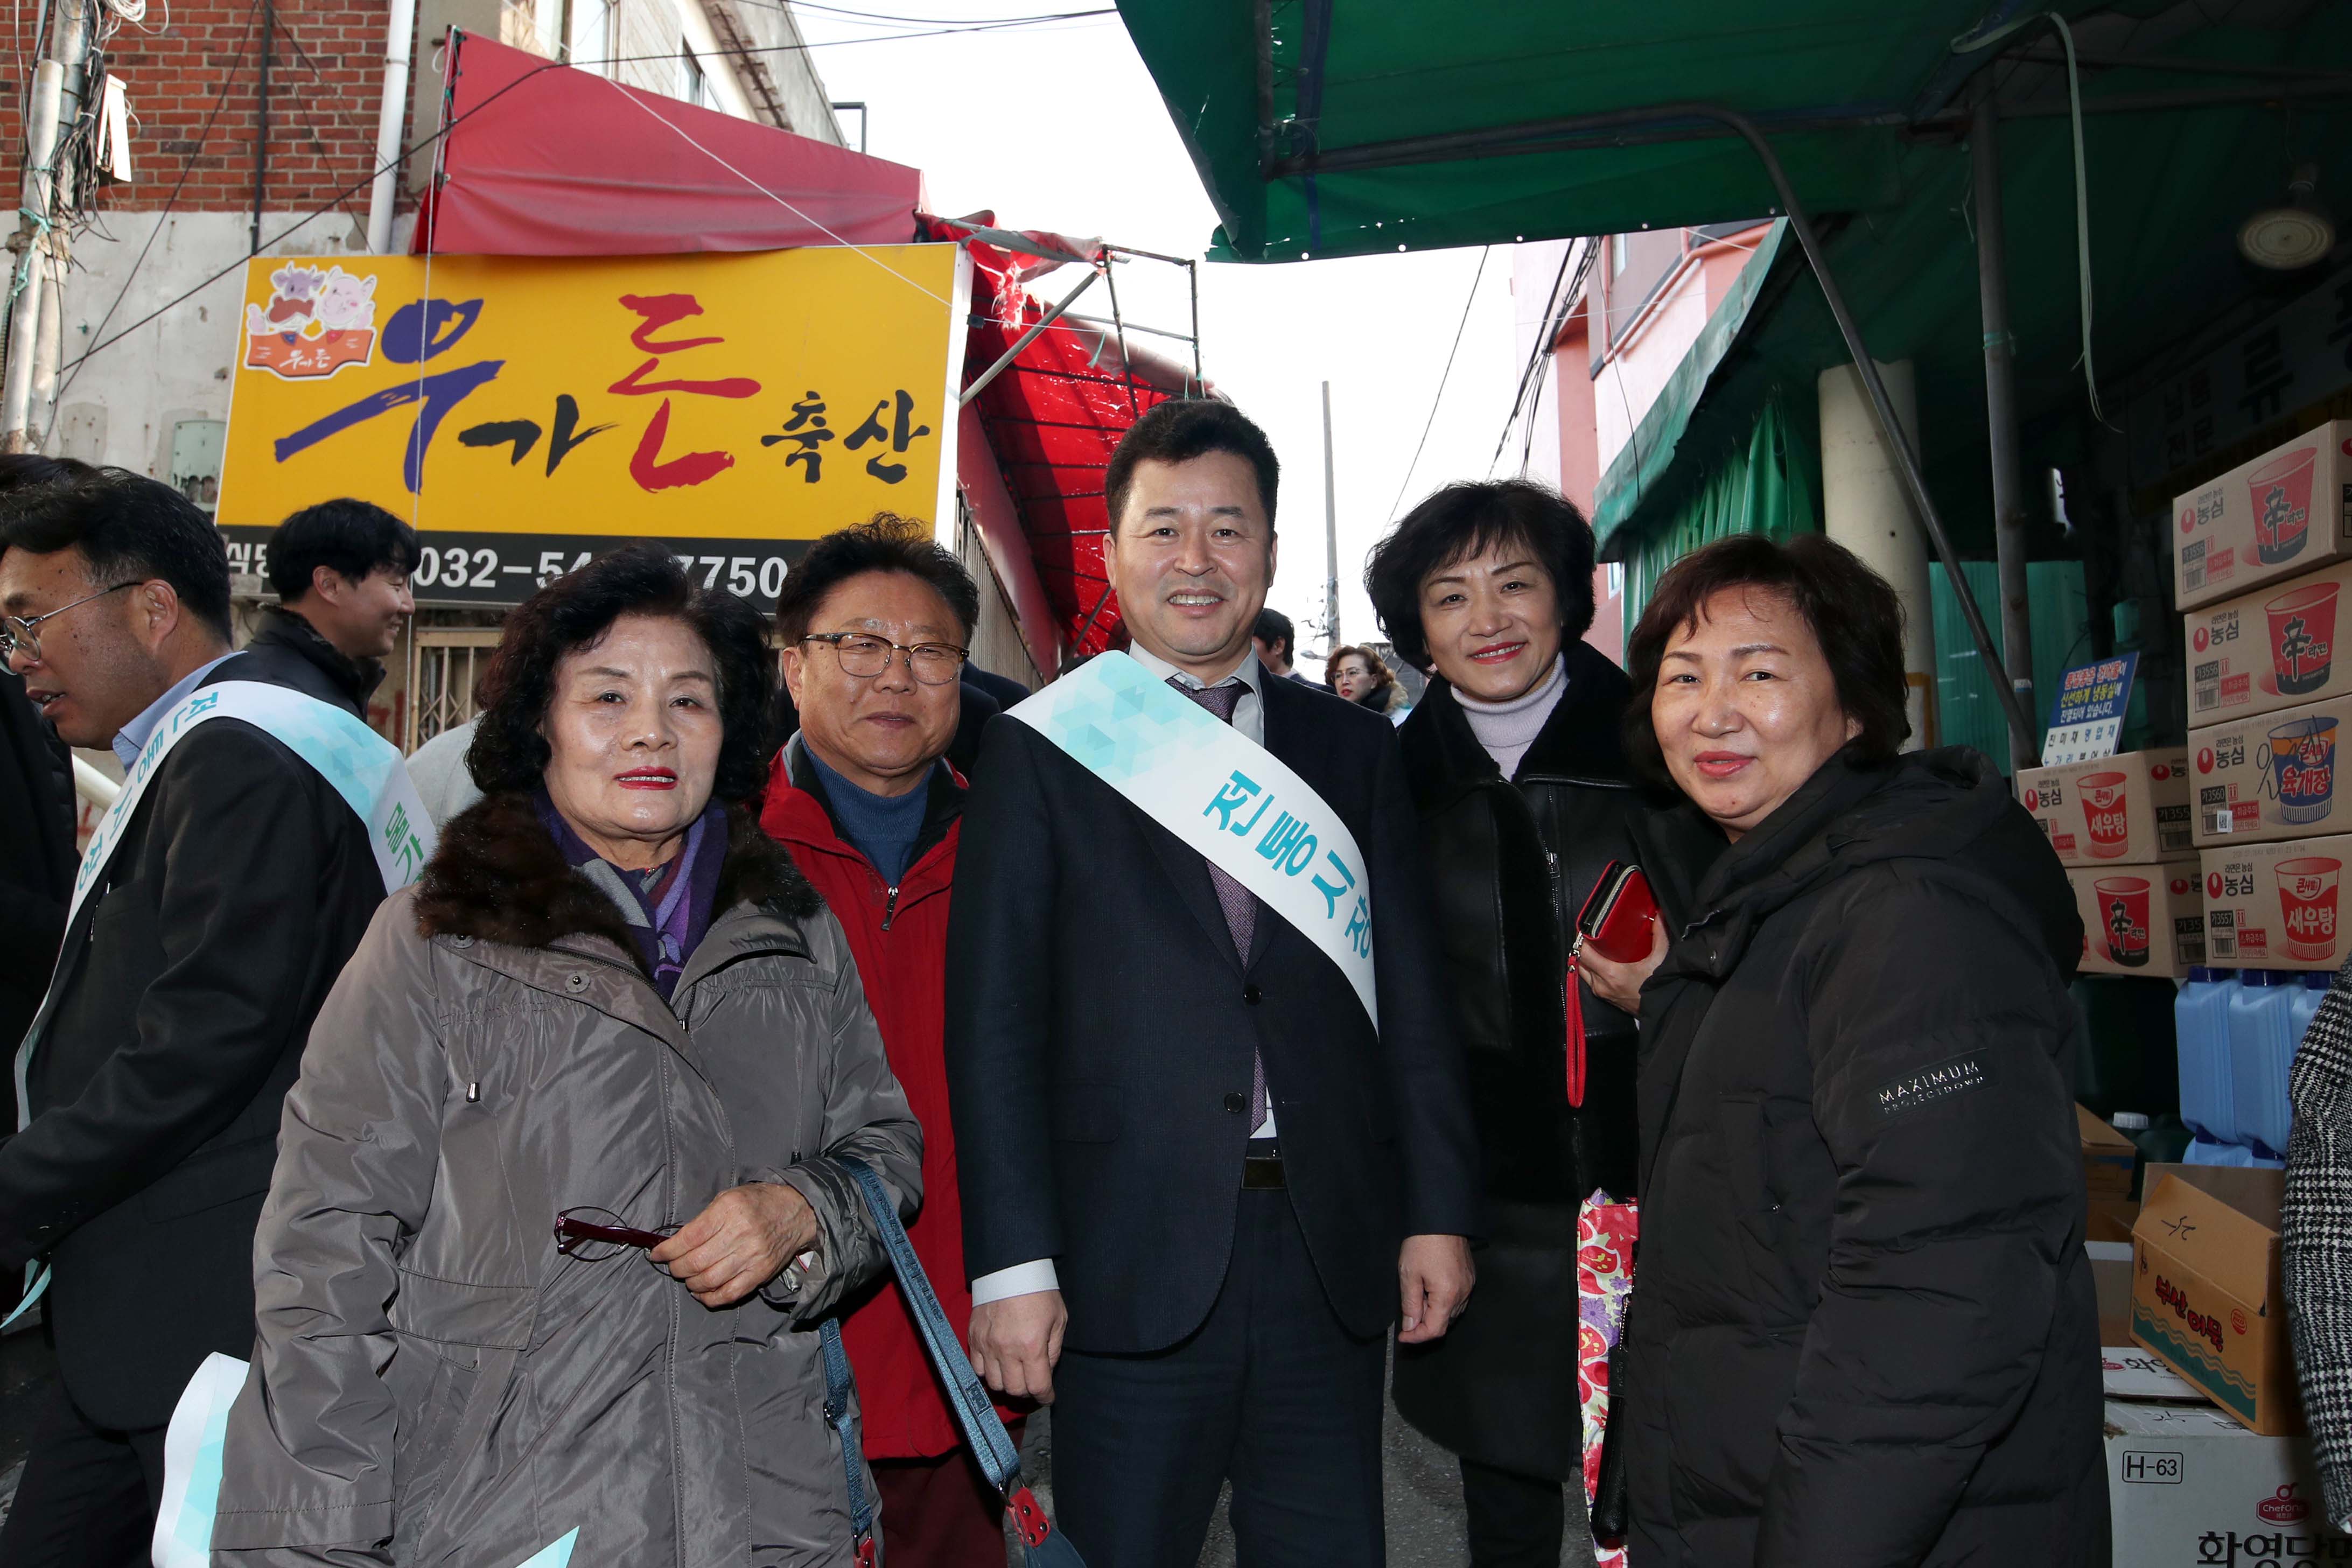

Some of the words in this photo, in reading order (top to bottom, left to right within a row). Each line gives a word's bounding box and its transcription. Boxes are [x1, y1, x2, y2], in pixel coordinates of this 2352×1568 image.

[760, 389, 930, 485] 축산
[2197, 497, 2224, 526] 농심
[2211, 620, 2239, 646] 농심
[2281, 615, 2312, 683] 辛
[2061, 687, 2092, 708] 신선하게
[2232, 735, 2244, 746] 농심
[2216, 746, 2244, 769] 농심
[79, 691, 219, 891] 전통시장
[2281, 766, 2331, 798] 육개장
[2039, 789, 2062, 808] 농심
[2202, 788, 2225, 804] 가3560
[2091, 812, 2126, 836] 새우탕
[1202, 769, 1371, 959] 전통시장
[2225, 864, 2241, 873] 라면은
[2242, 862, 2253, 873] 농심
[2225, 874, 2254, 897] 농심
[2211, 913, 2232, 926] 가3557
[2287, 906, 2335, 935] 새우탕
[1878, 1061, 1979, 1104] MAXIMUM
[2126, 1455, 2177, 1479] H-63
